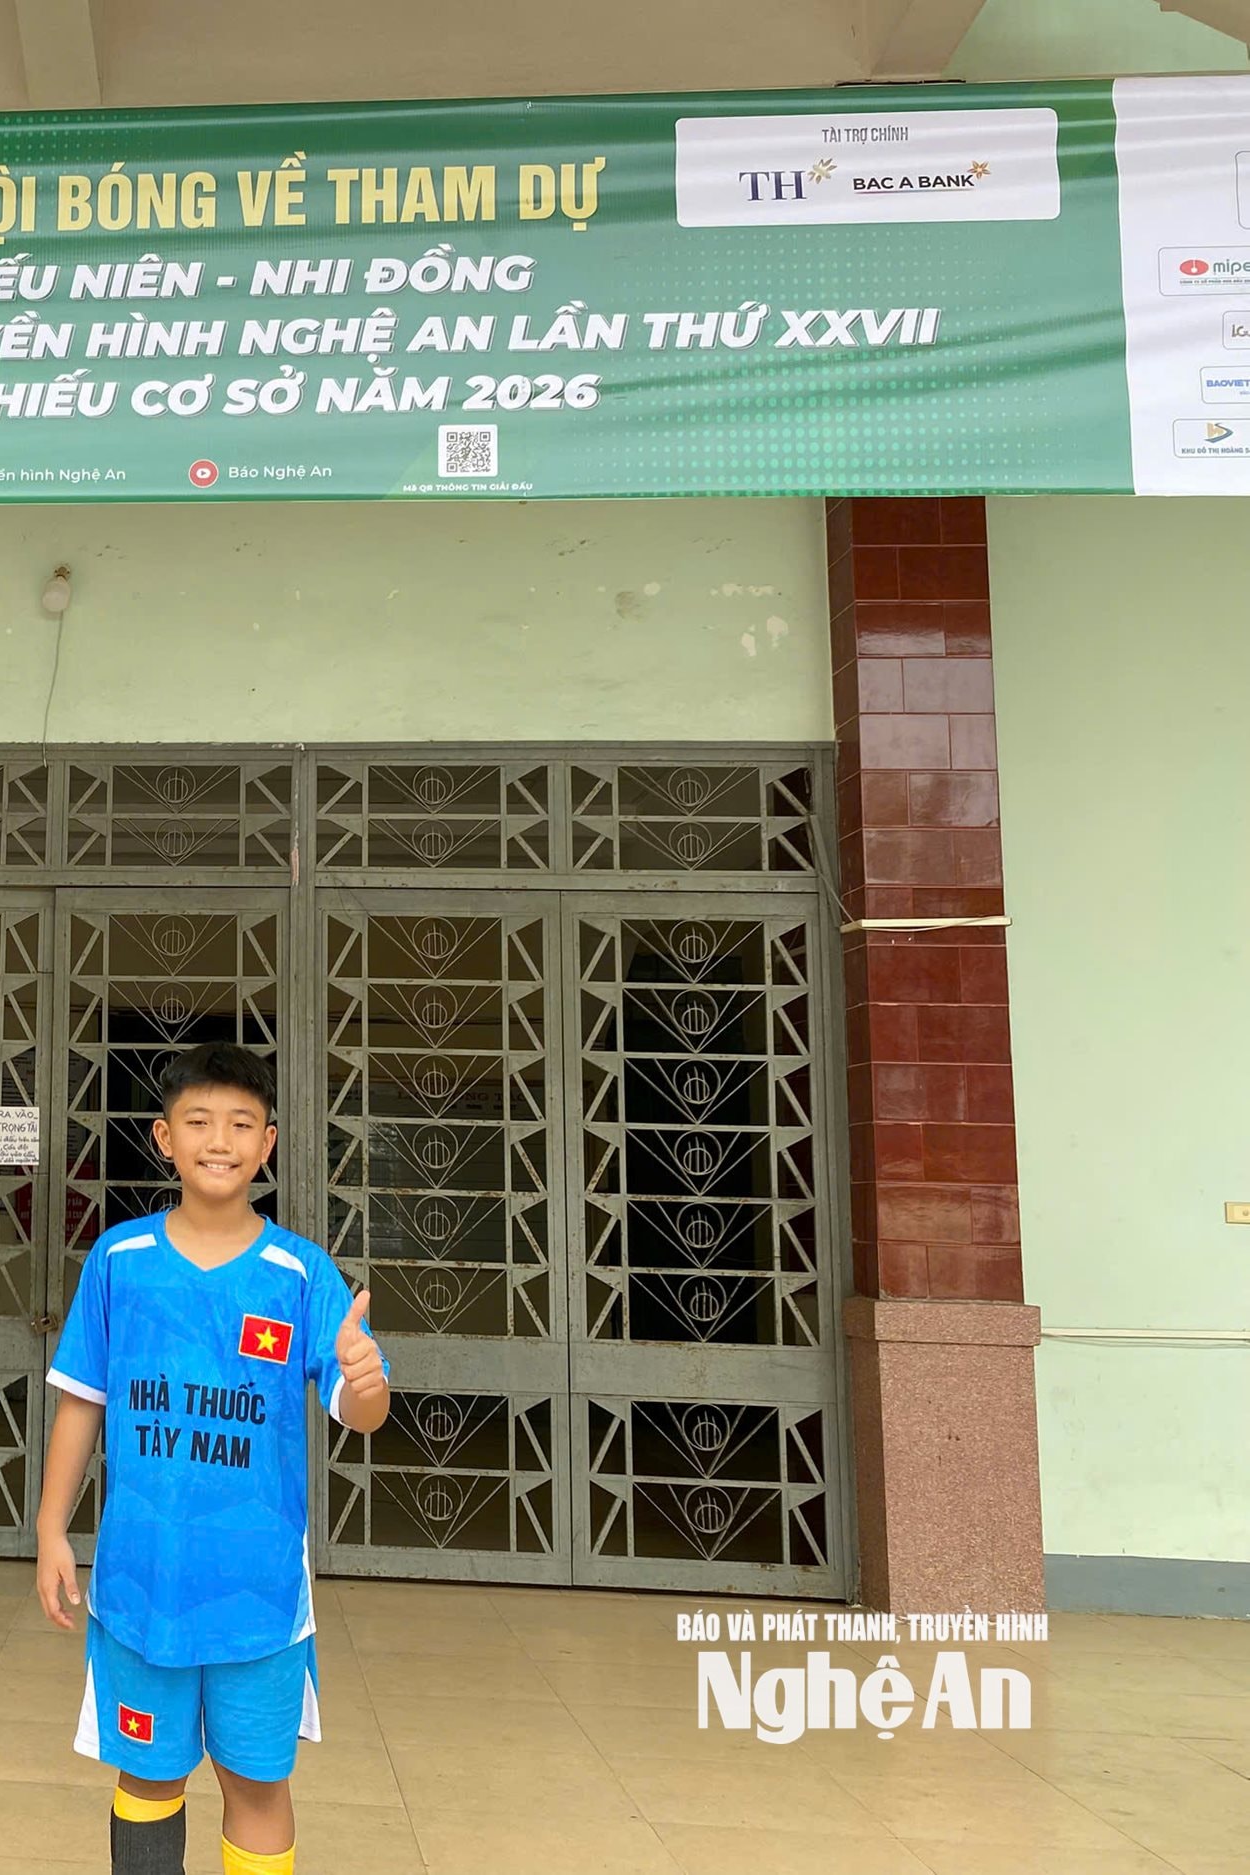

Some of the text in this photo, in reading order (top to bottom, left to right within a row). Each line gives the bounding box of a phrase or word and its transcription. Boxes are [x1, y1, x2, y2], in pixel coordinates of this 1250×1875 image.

[822, 125, 909, 145] TÀI TRỢ CHÍNH
[57, 162, 216, 232] BÓNG
[237, 151, 307, 227] VỀ
[327, 165, 496, 224] THAM
[519, 157, 606, 231] DỰ
[738, 171, 807, 201] TH
[853, 175, 975, 191] BAC A BANK
[69, 253, 205, 299] NIÊN
[249, 259, 354, 296] NHI
[363, 243, 537, 294] ĐỒNG
[85, 312, 229, 359] HÌNH
[238, 307, 399, 365] NGHỆ
[406, 315, 496, 352] AN
[507, 300, 628, 351] LẦN
[642, 300, 771, 349] THỨ
[774, 308, 942, 348] XXVII
[130, 373, 215, 418] CƠ
[222, 364, 307, 415] SỞ
[315, 366, 452, 414] NĂM
[462, 373, 602, 411] 2026
[20, 468, 54, 481] hình
[59, 468, 100, 484] Nghệ
[104, 468, 126, 480] An
[229, 464, 332, 480] Báo Nghệ An
[435, 482, 469, 492] THÔNG
[471, 483, 487, 491] TIN
[129, 1373, 266, 1425] NHÀ THUỐC
[135, 1418, 250, 1469] TÂY NAM
